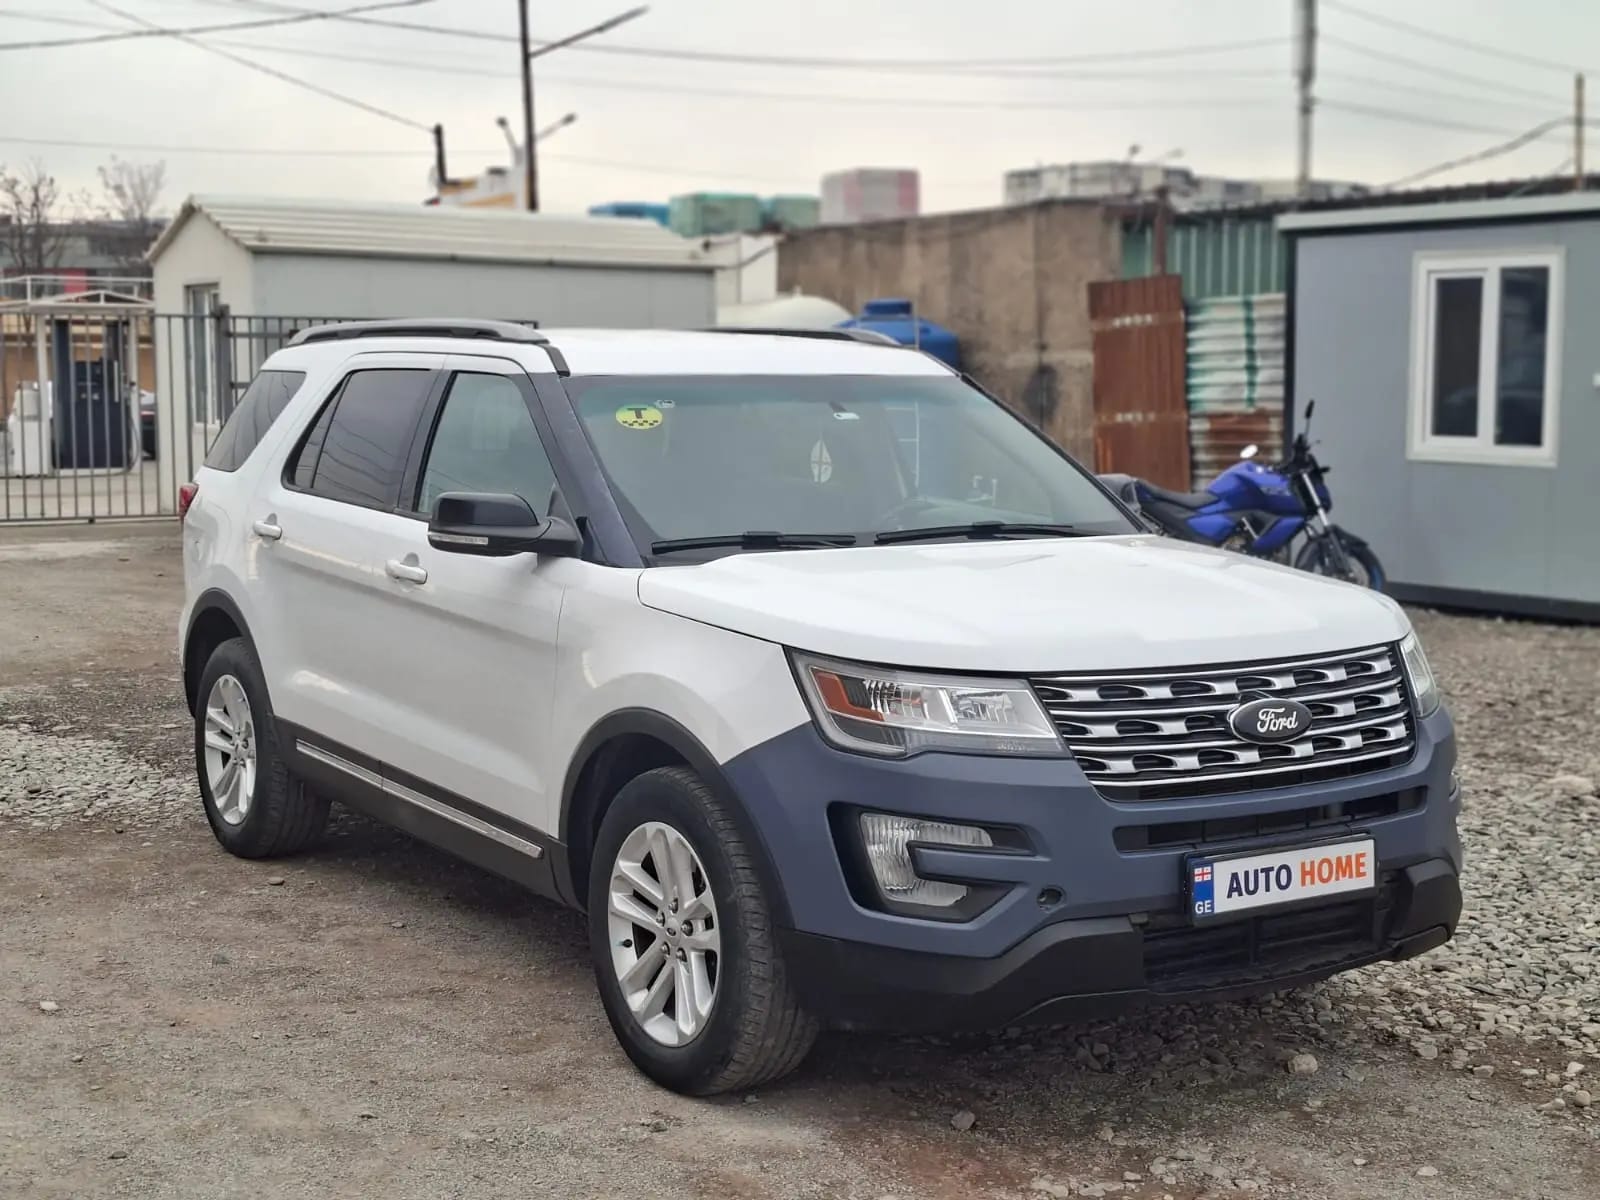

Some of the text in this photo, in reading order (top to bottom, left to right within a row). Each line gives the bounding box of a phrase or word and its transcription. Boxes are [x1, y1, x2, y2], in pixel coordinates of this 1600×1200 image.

[1256, 707, 1299, 733] Ford
[1226, 852, 1367, 899] AUTO HOME
[1195, 900, 1212, 914] GE
